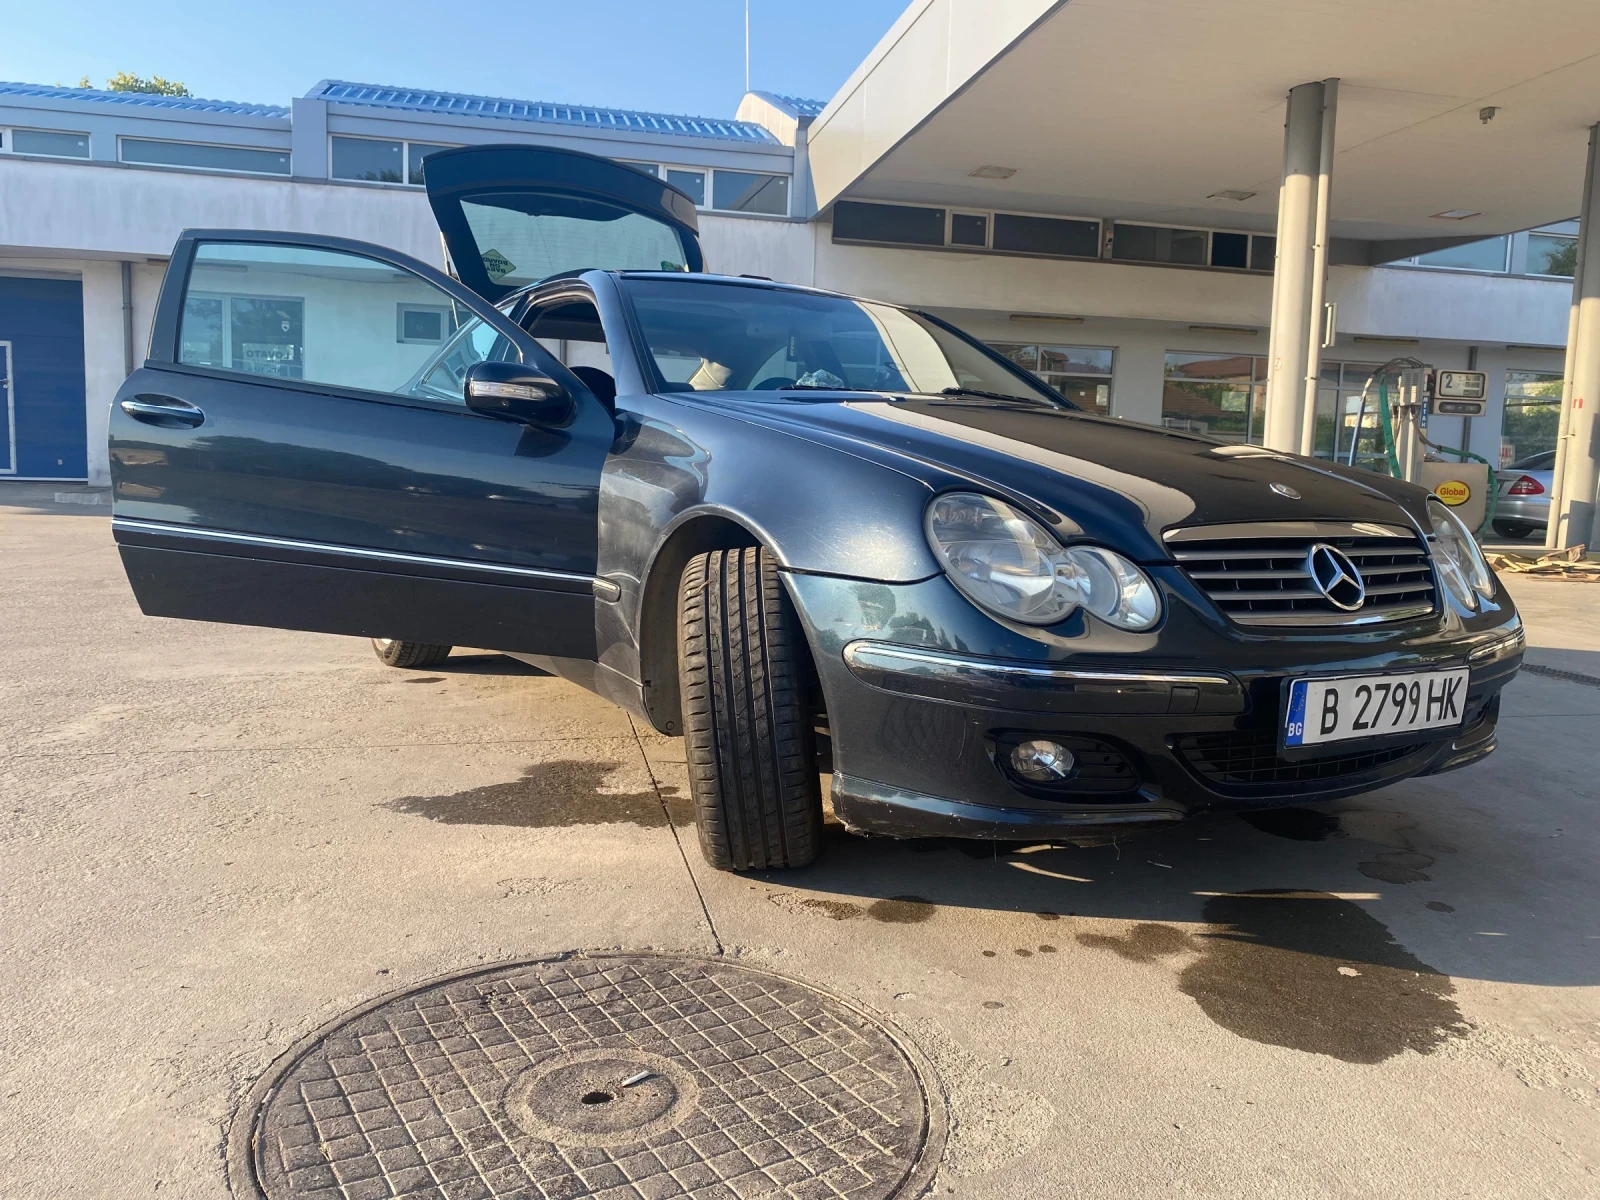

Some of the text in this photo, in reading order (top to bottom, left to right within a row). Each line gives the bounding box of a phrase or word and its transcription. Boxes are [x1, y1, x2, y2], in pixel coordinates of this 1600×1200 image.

[482, 257, 508, 265] BOARD
[1445, 373, 1453, 389] 2
[1440, 487, 1466, 496] Global
[1319, 677, 1463, 736] B 2799 HK
[1287, 722, 1302, 737] BG
